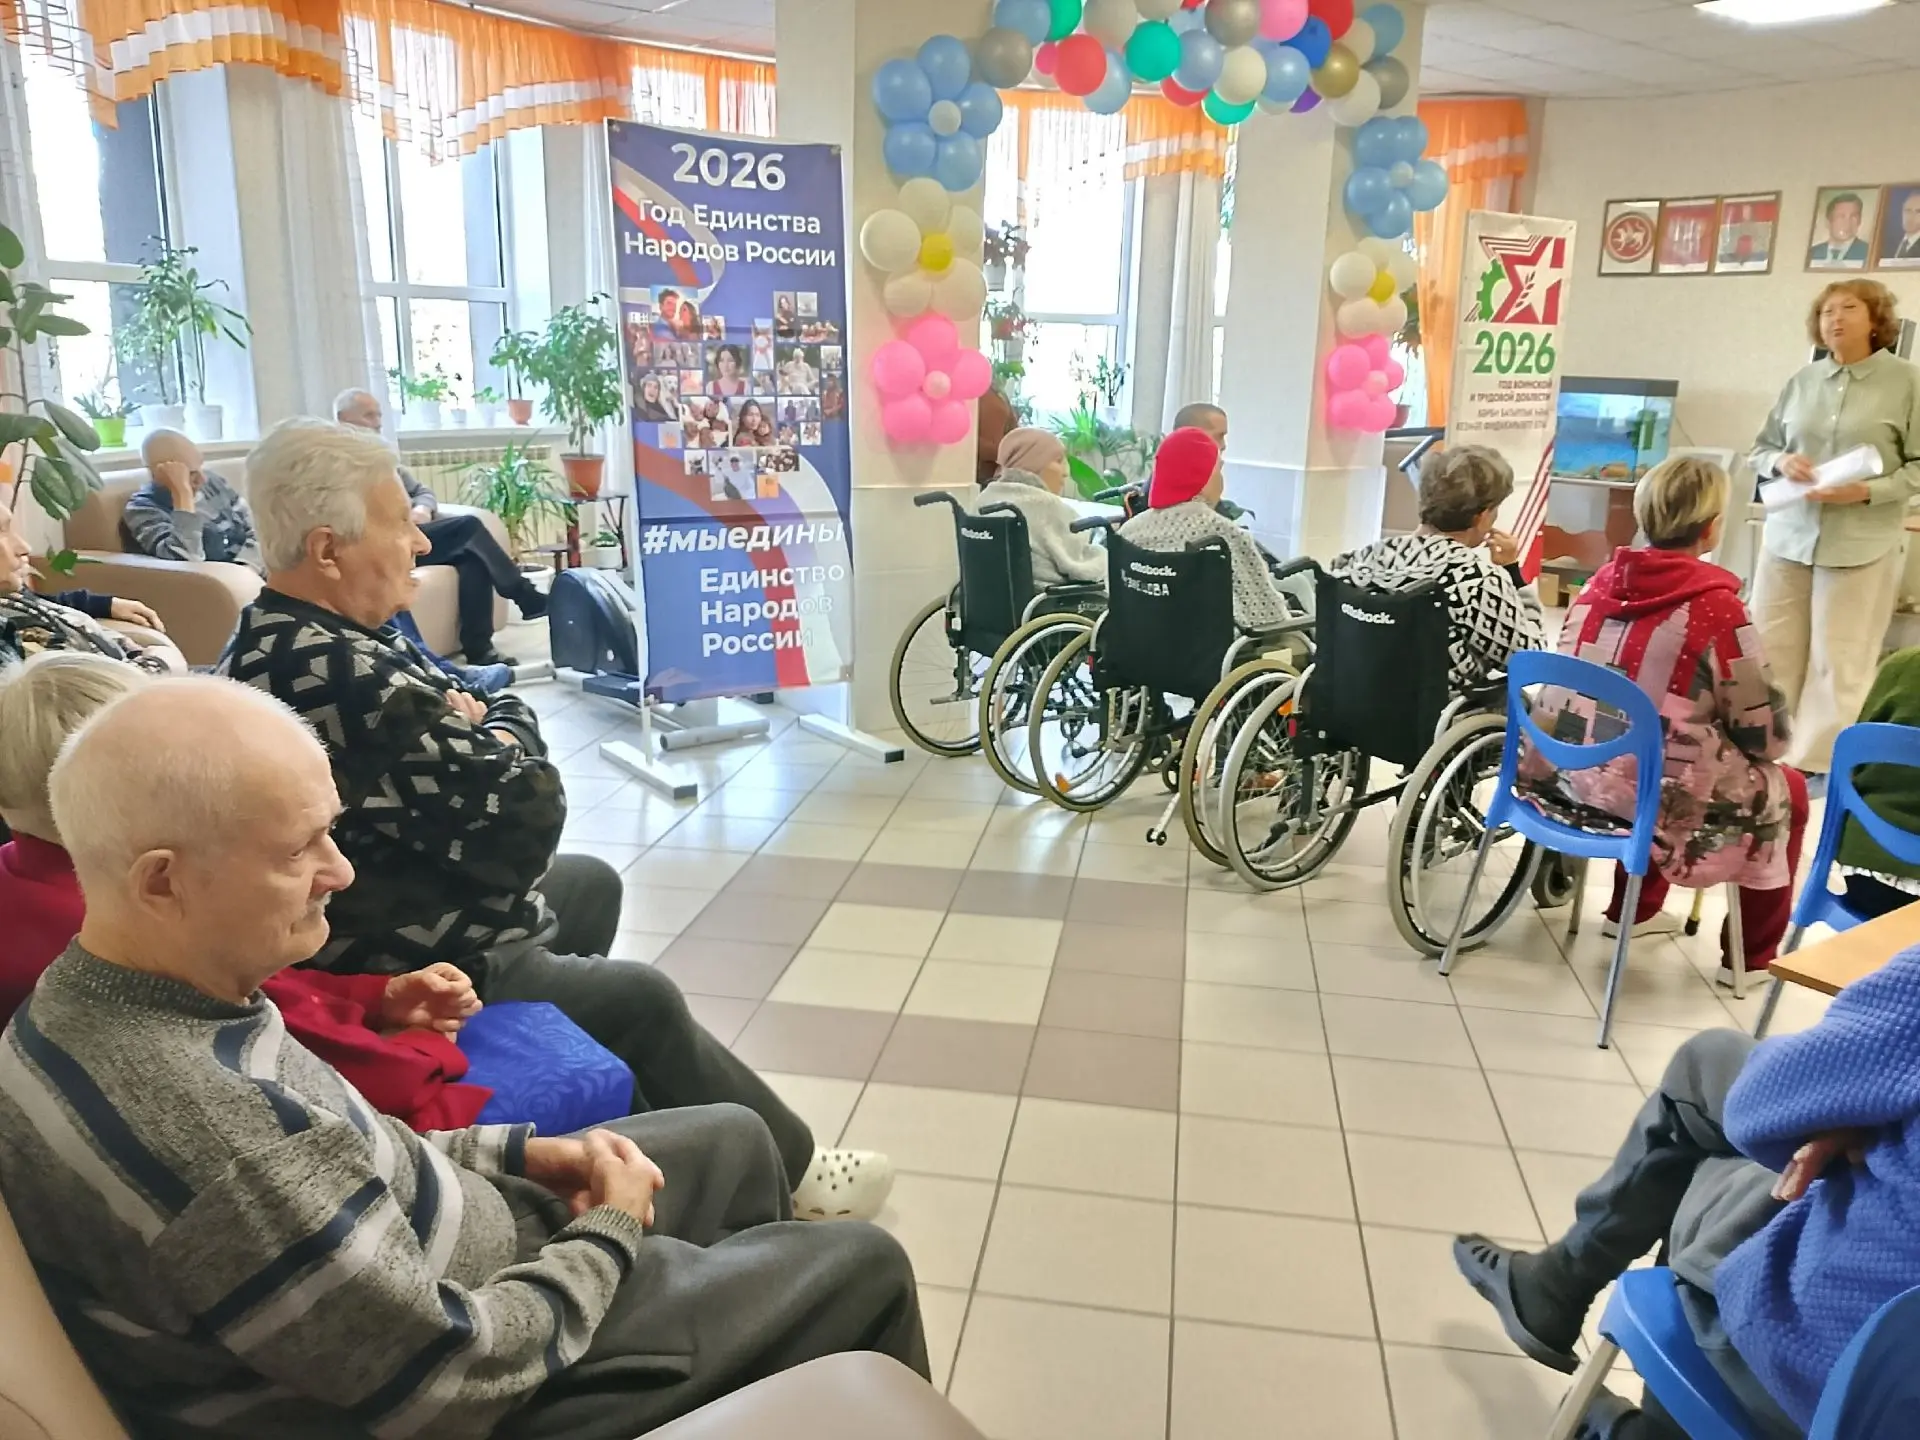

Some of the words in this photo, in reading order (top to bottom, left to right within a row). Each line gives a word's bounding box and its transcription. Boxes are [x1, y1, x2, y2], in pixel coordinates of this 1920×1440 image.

[671, 143, 786, 191] 2026
[638, 199, 685, 227] Год
[693, 203, 821, 234] Единства
[624, 232, 740, 262] Народов
[745, 241, 836, 267] России
[1473, 330, 1556, 374] 2026
[642, 522, 844, 554] #мыедины
[700, 564, 845, 595] Единство
[701, 596, 833, 627] Народов
[702, 628, 814, 658] России
